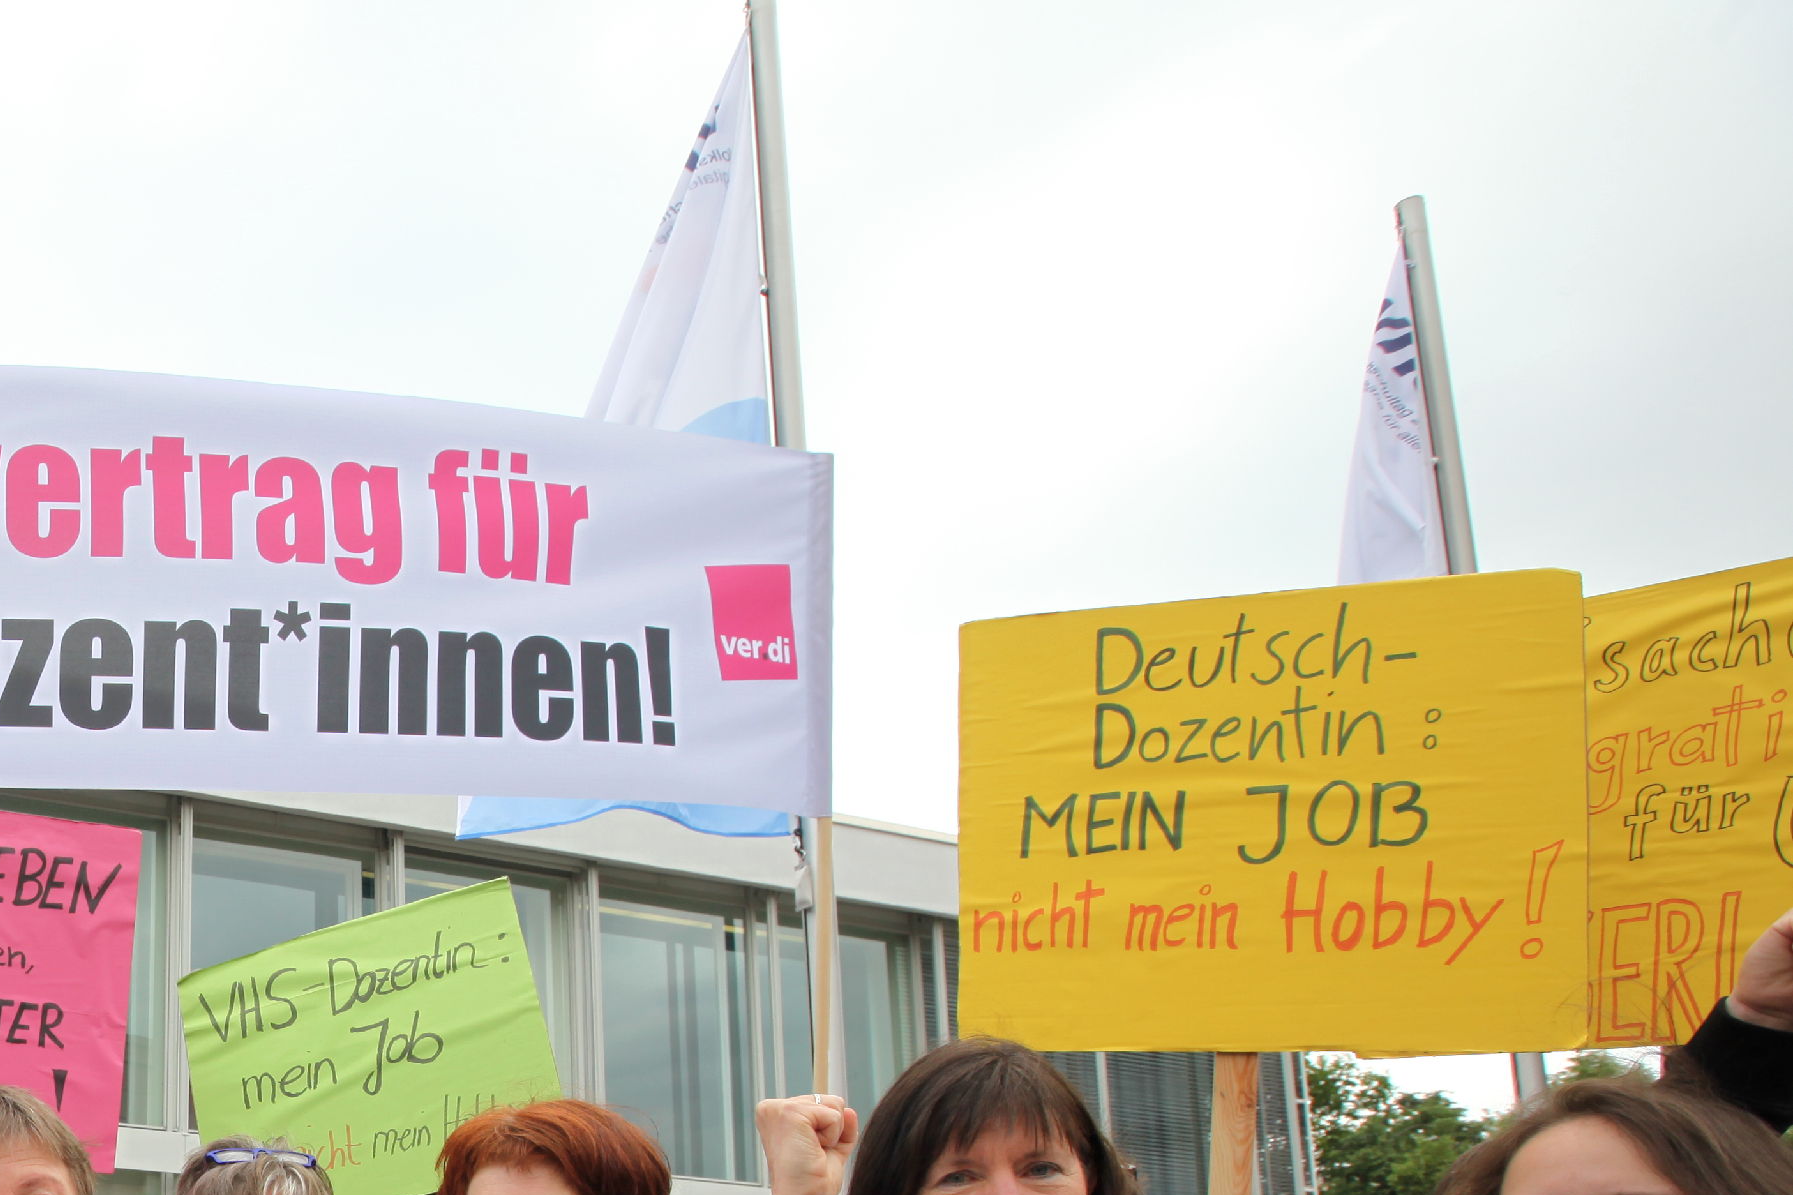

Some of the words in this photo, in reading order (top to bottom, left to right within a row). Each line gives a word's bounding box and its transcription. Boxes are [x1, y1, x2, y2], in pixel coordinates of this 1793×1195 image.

[427, 447, 590, 587] für
[1094, 601, 1420, 697] Deutsch-
[1018, 790, 1187, 860] MEIN
[1236, 779, 1431, 866] JOB
[1622, 782, 1751, 861] für
[971, 876, 1106, 954] nicht
[1123, 883, 1240, 953] mein
[241, 1050, 339, 1110] mein
[349, 1010, 444, 1097] Job
[372, 1110, 432, 1159] mein
